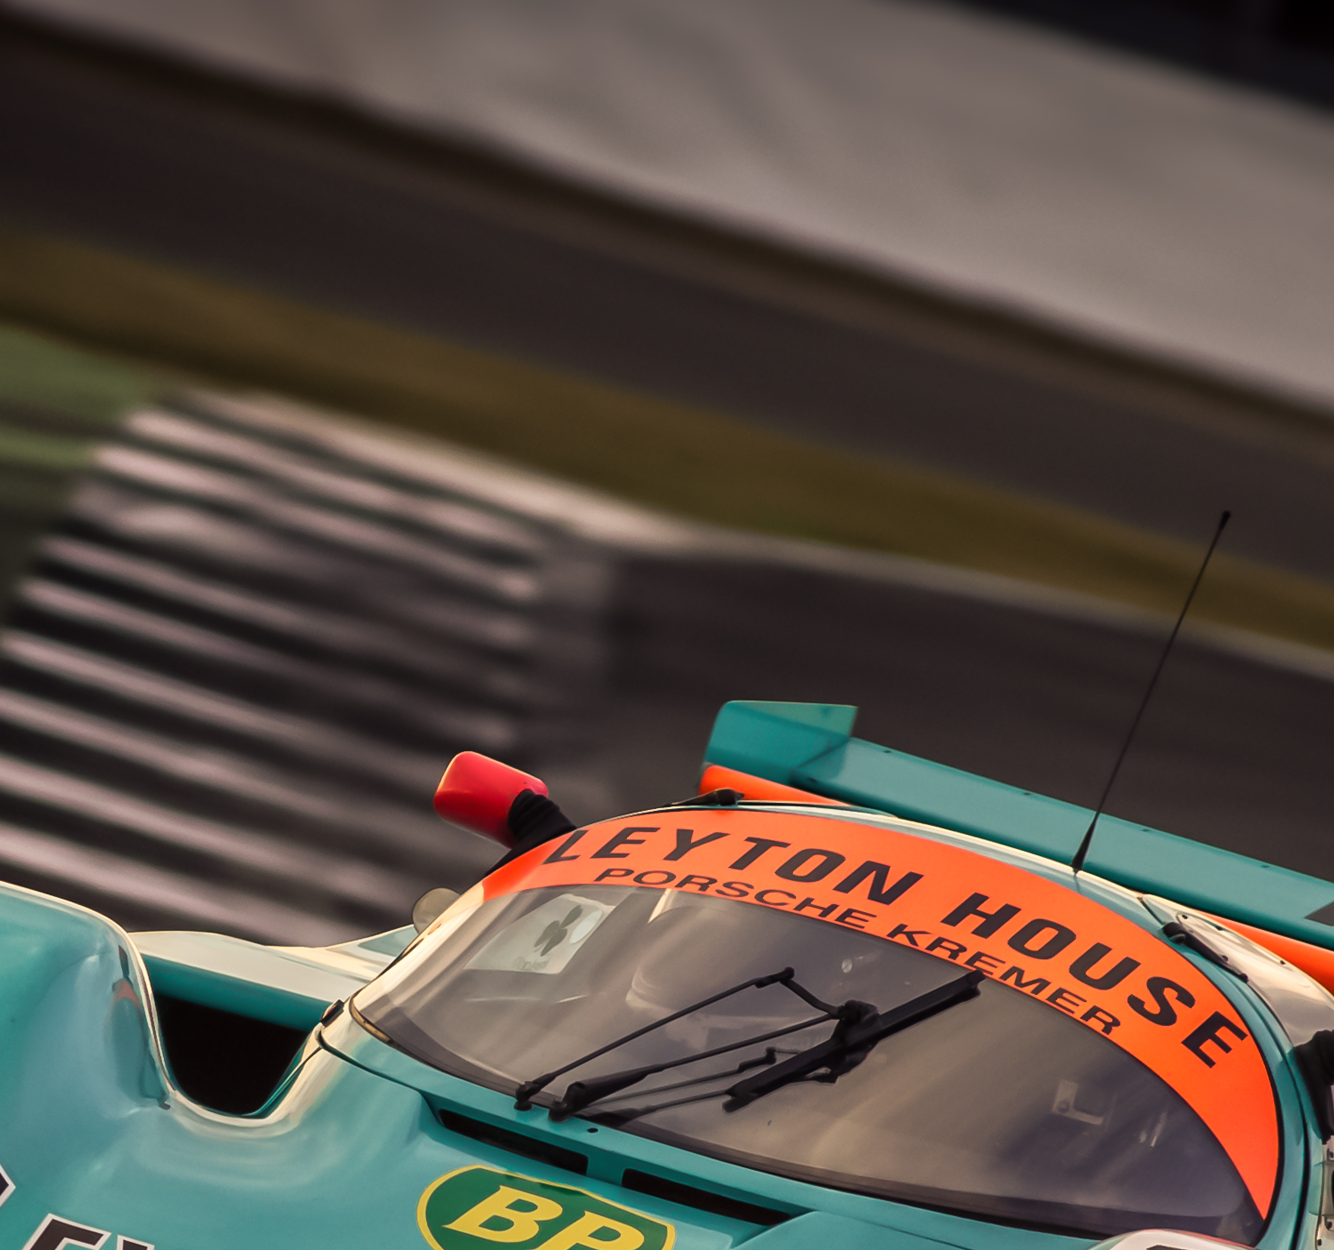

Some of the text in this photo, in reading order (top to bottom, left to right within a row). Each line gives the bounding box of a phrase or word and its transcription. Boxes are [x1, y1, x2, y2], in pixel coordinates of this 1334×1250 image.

[541, 826, 1249, 1068] LEYTON HOUSE
[594, 867, 1121, 1035] PORSCHE KREMER
